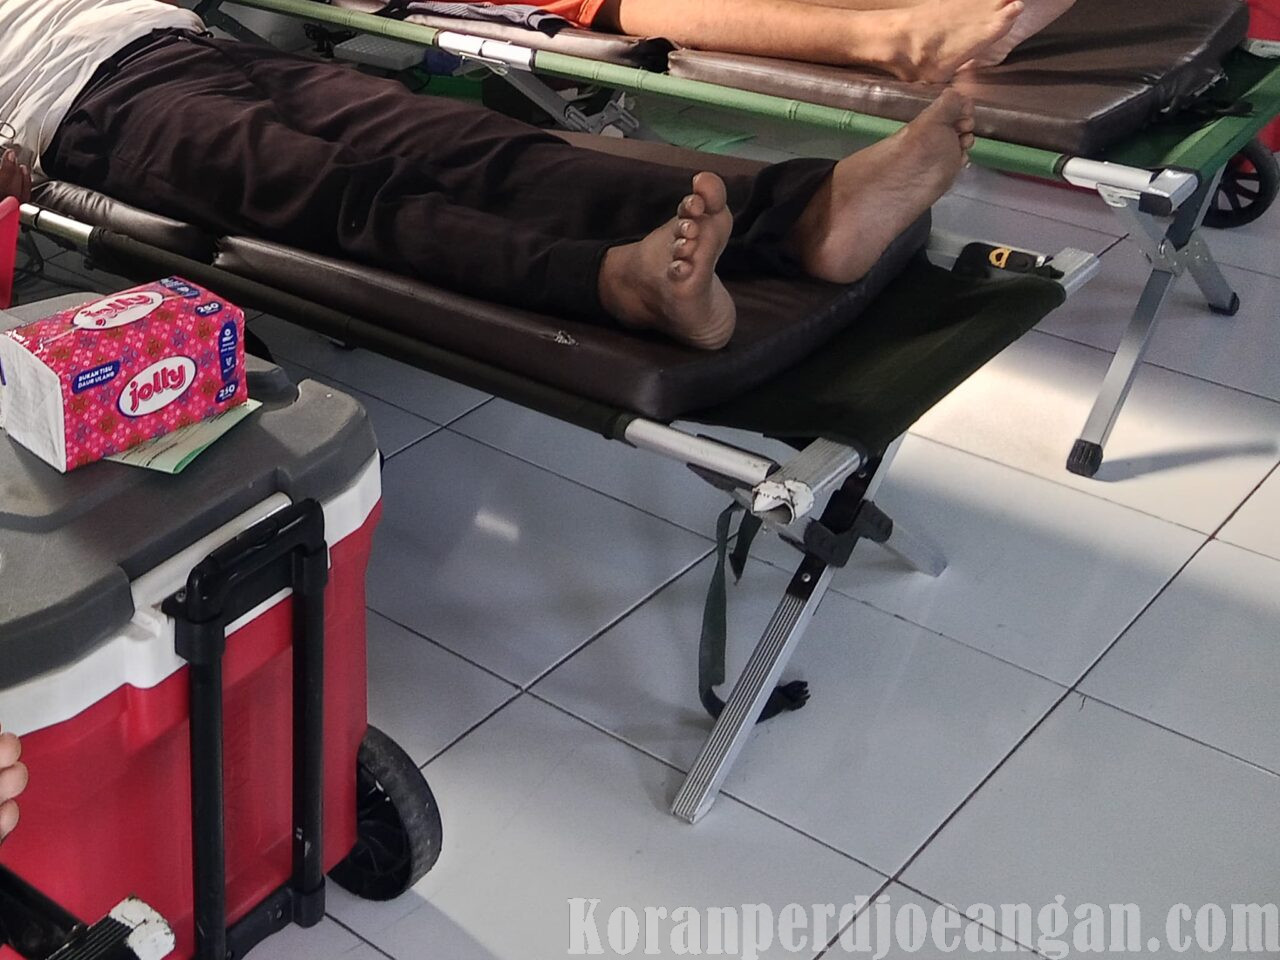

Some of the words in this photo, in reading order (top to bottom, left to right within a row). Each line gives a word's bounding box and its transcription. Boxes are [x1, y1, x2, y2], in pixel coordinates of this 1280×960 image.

[197, 302, 218, 313] 250
[77, 378, 95, 389] DAUR
[95, 371, 115, 383] ULANG
[78, 369, 100, 382] BUKAN
[99, 365, 113, 376] TISU
[129, 365, 187, 413] jolly
